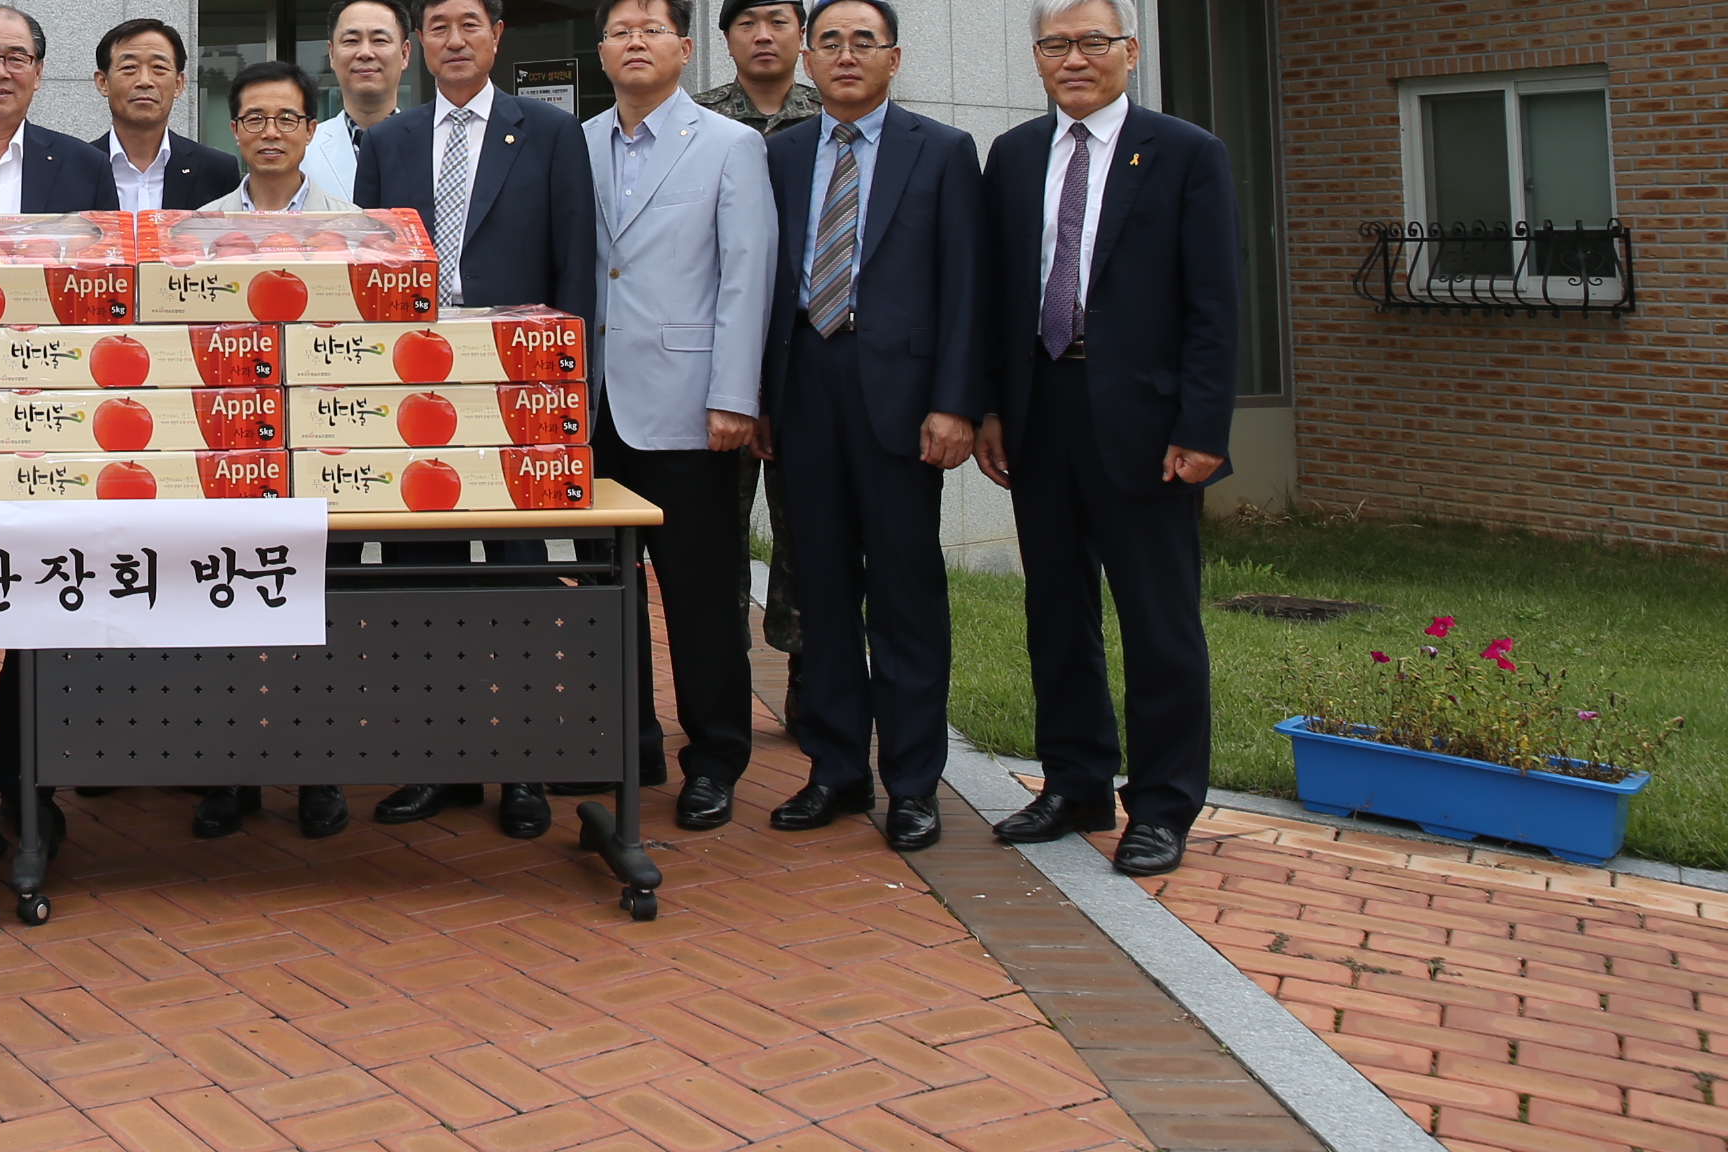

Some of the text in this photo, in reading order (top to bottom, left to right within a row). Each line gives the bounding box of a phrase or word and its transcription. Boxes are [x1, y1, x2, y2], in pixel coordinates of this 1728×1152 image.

[528, 73, 546, 81] CCTV
[64, 272, 127, 298] Apple
[168, 272, 223, 303] 반딧불
[367, 267, 432, 292] Apple
[111, 306, 125, 316] 5kg
[415, 301, 429, 311] 5kg
[208, 331, 273, 357] Apple
[314, 334, 368, 365] 반딧불
[512, 325, 576, 351] Apple
[11, 339, 65, 369] 반딧불
[559, 359, 574, 369] 5kg
[256, 365, 270, 375] 5kg
[211, 394, 276, 419] Apple
[318, 396, 372, 427] 반딧불
[515, 388, 580, 413] Apple
[14, 402, 68, 433] 반딧불
[563, 422, 577, 432] 5kg
[259, 428, 273, 437] 5kg
[215, 458, 280, 483] Apple
[322, 463, 376, 494] 반딧불
[519, 454, 584, 480] Apple
[18, 465, 71, 495] 반딧불
[567, 488, 581, 498] 5kg
[190, 545, 297, 608] 방문
